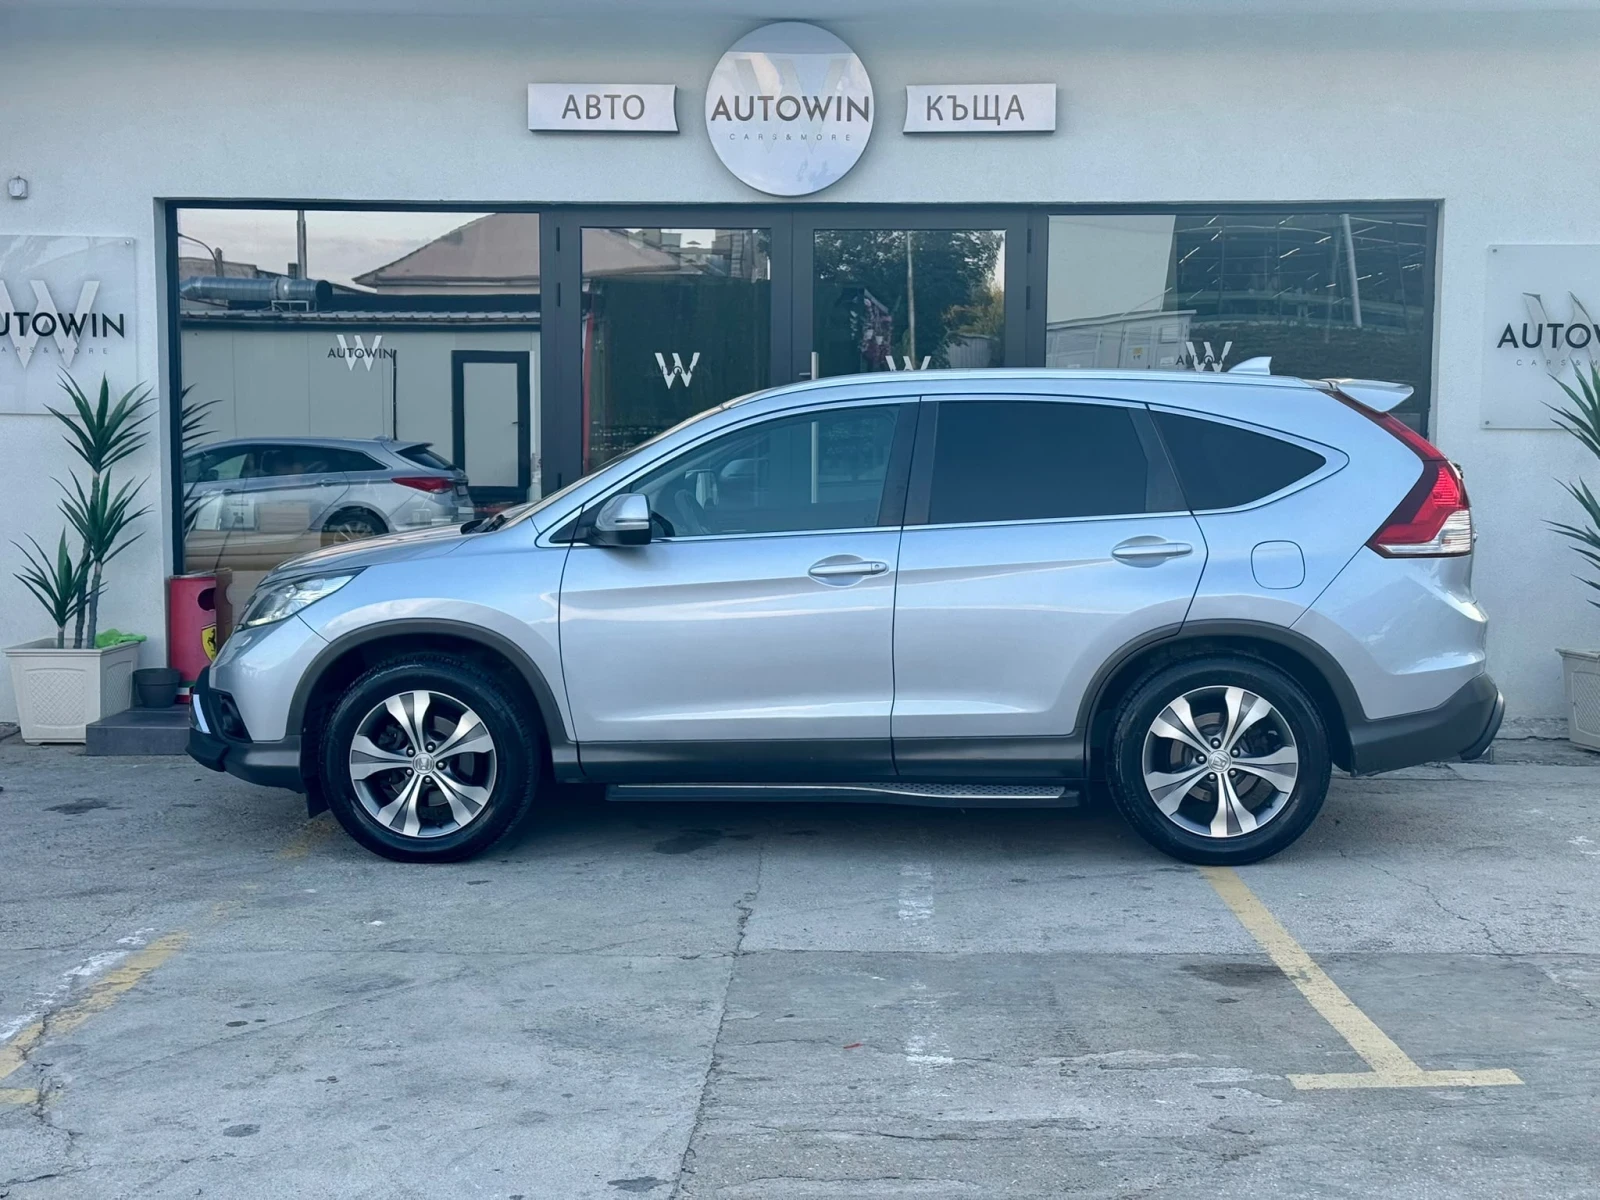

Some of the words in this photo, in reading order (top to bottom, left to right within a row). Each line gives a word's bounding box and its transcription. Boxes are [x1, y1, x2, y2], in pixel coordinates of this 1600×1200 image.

[561, 94, 645, 120] АВТО
[710, 95, 869, 122] AUTOWIN
[926, 94, 1025, 126] КЪЩА
[1497, 323, 1600, 349] AUTO
[327, 347, 394, 359] AUTOWIN
[336, 334, 383, 372] W
[654, 352, 701, 389] W
